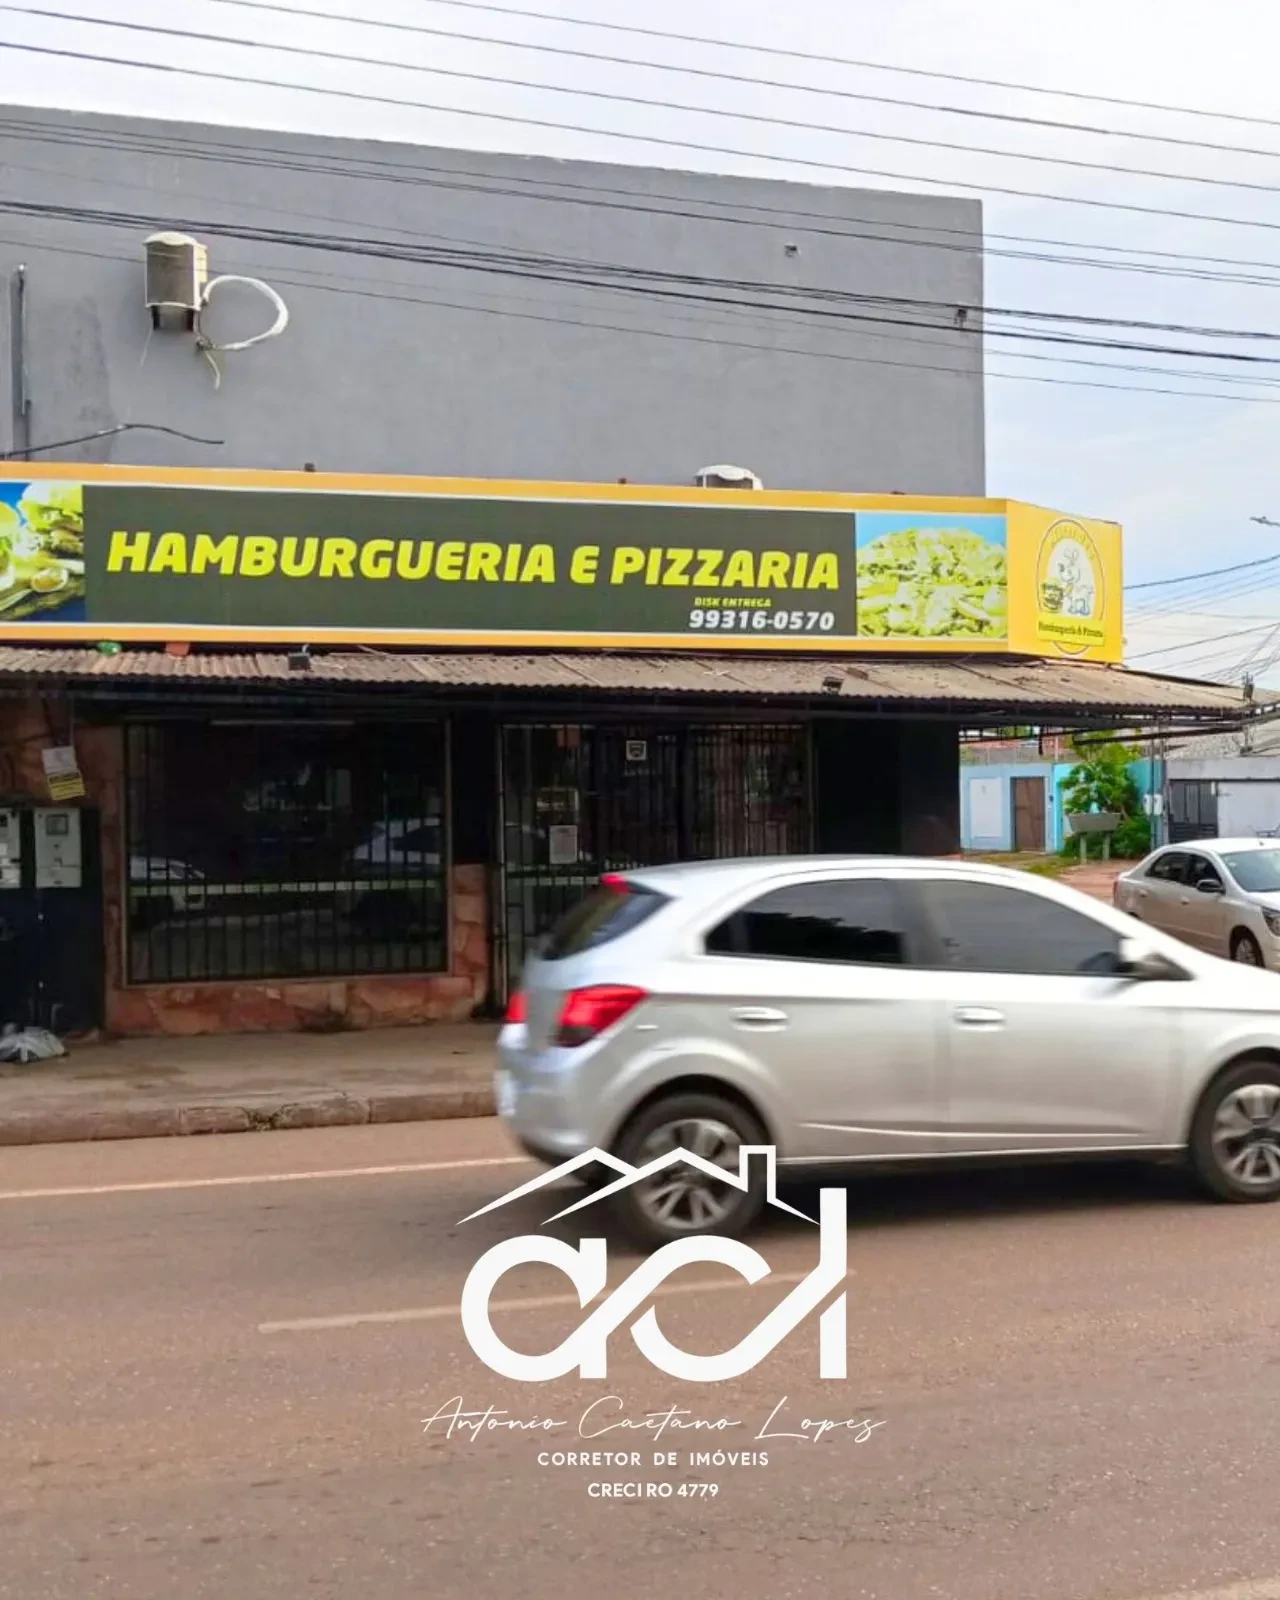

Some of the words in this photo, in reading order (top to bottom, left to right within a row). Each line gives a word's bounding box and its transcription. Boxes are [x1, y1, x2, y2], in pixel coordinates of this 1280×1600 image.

[106, 530, 556, 583] HAMBURGUERIA
[570, 545, 600, 585] E
[610, 546, 839, 590] PIZZARIA
[693, 596, 720, 607] DISK
[688, 609, 835, 631] 99316-0570
